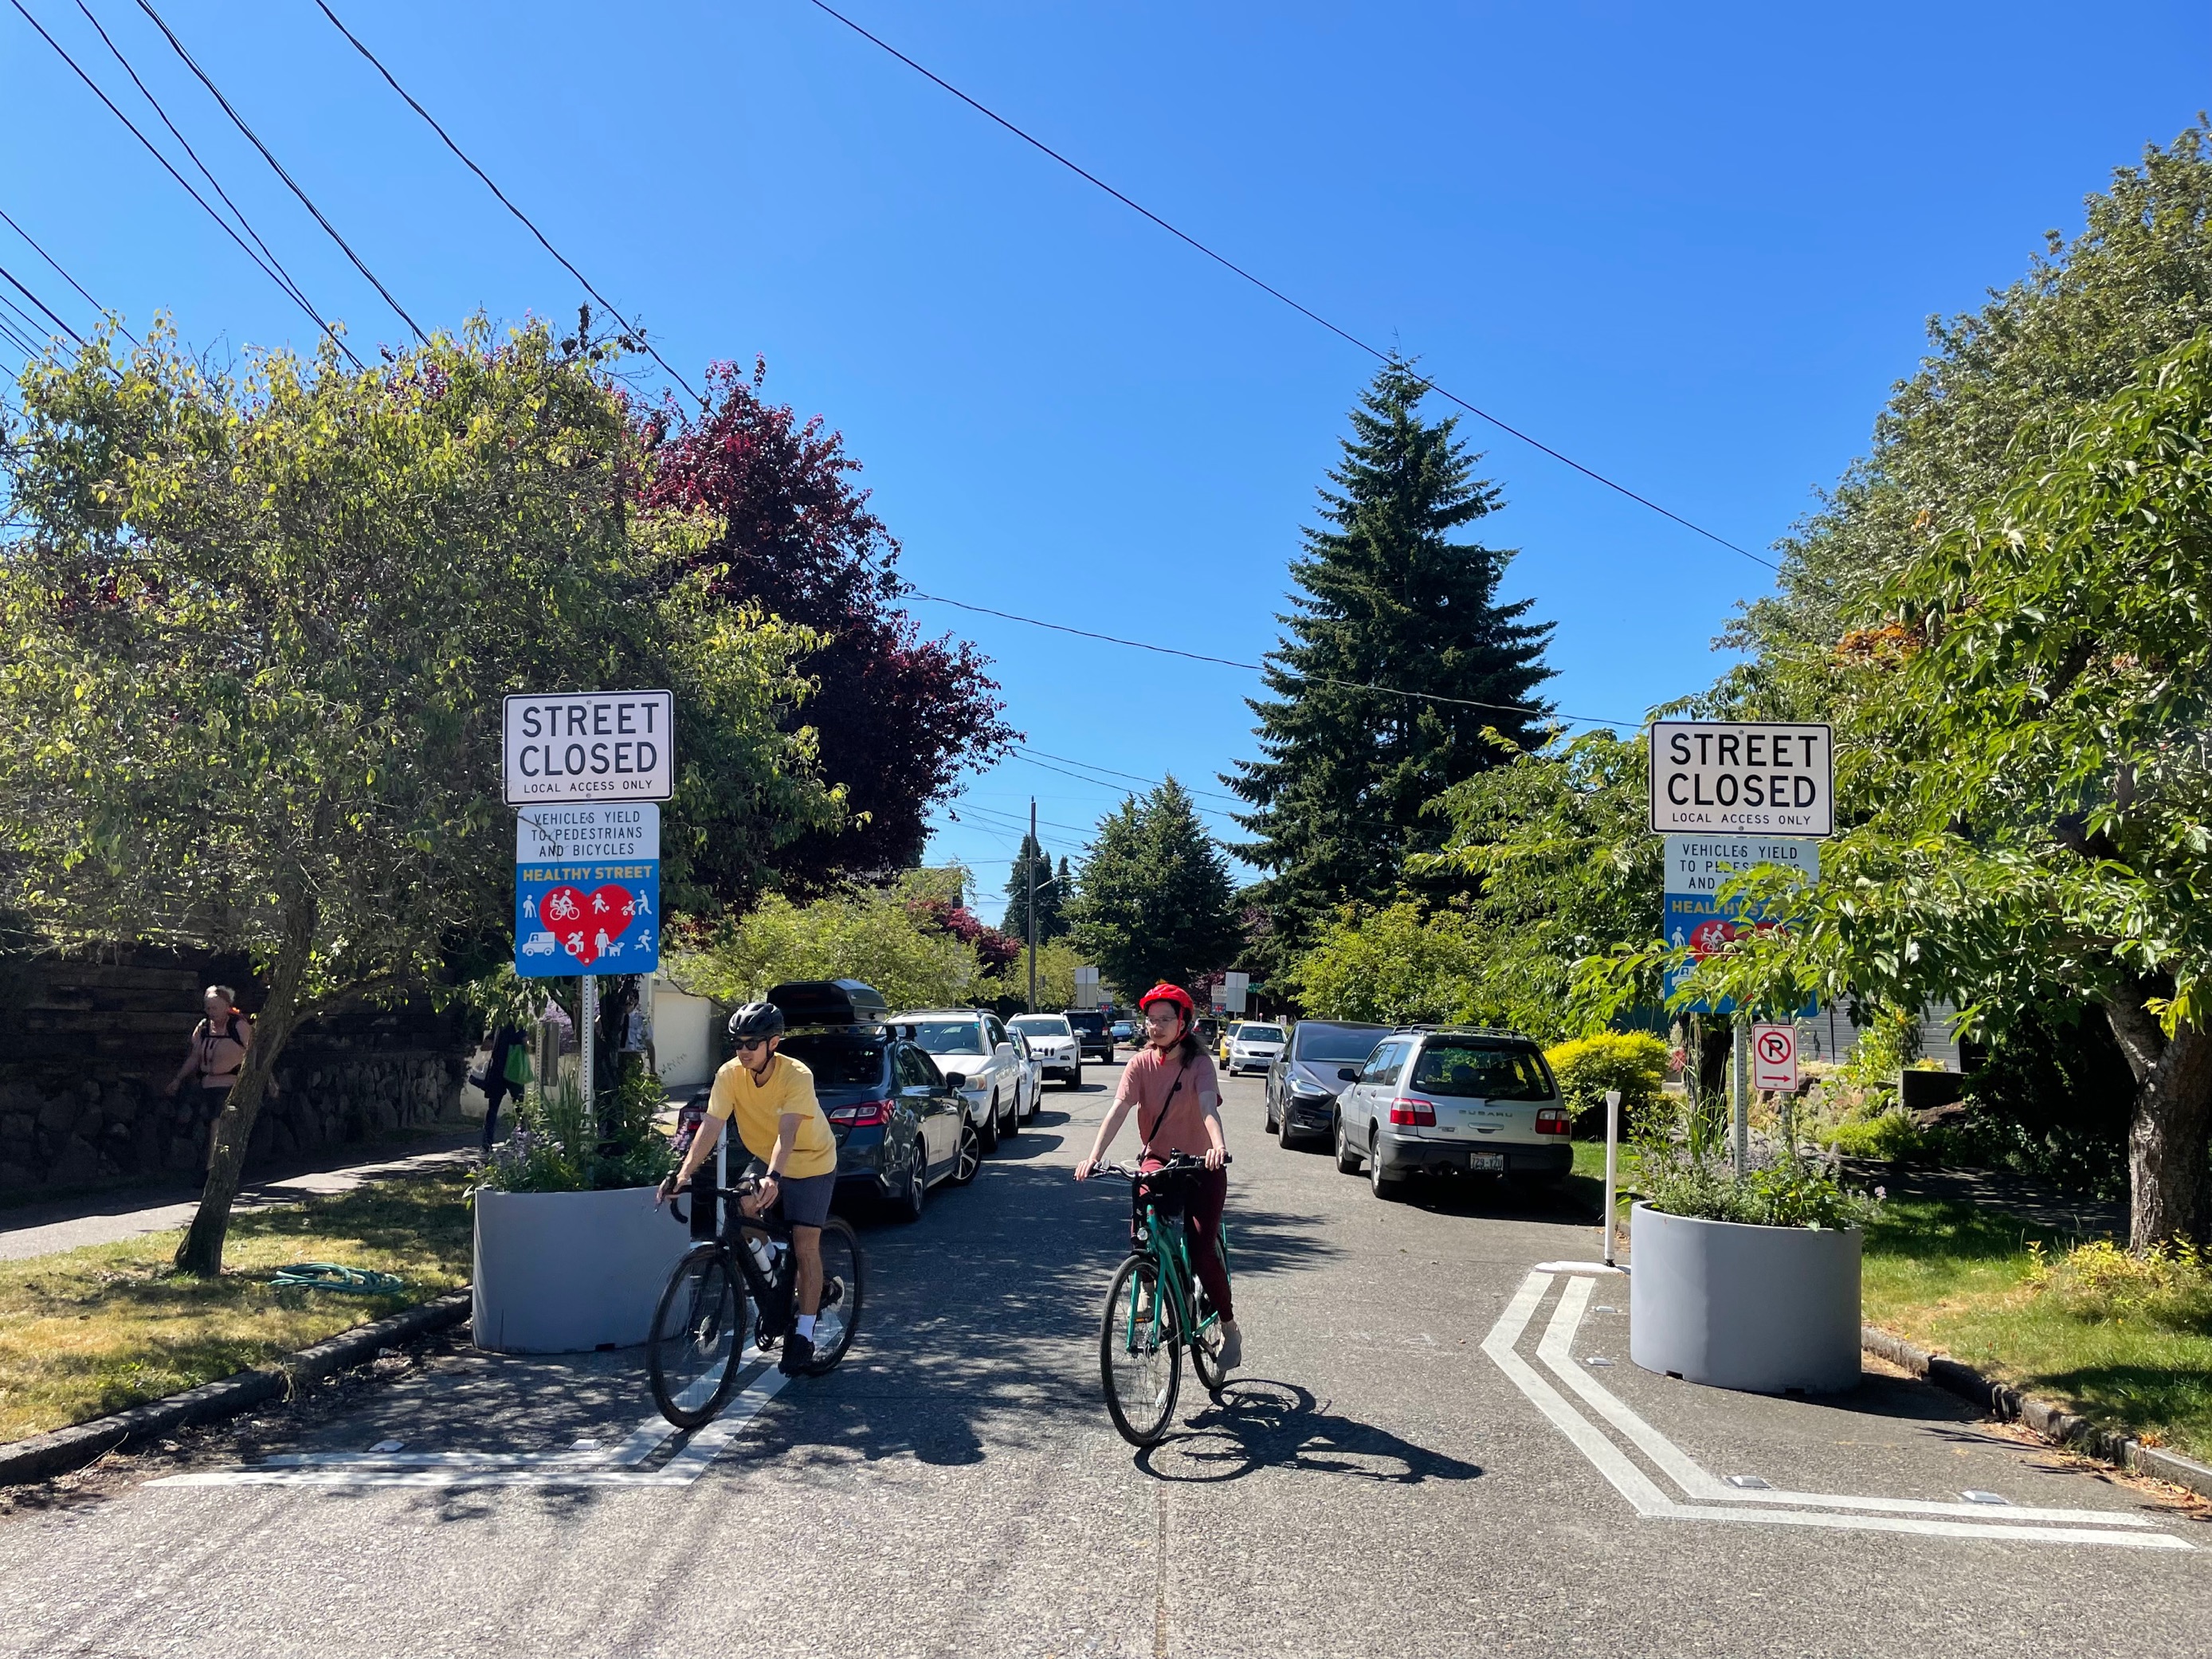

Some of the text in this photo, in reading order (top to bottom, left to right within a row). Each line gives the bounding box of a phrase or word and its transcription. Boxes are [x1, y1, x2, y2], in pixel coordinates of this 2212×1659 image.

[522, 703, 659, 738] STREET
[1669, 732, 1818, 767] STREET
[520, 741, 657, 777] CLOSED
[524, 779, 653, 794] LOCAL ACCESS ONLY
[1667, 772, 1816, 807] CLOSED
[534, 810, 640, 826] VEHICLES YIELD
[1673, 813, 1810, 825] LOCAL ACCESS ONLY
[531, 826, 642, 841] TO PEDESTRIANS
[539, 842, 634, 857] AND BICYCLES
[1682, 843, 1798, 859] VEHICLES YIELD
[523, 865, 653, 882] HEALTHY STREET
[1680, 860, 1696, 873] TO
[1688, 877, 1715, 889] AND
[1768, 1039, 1783, 1057] P
